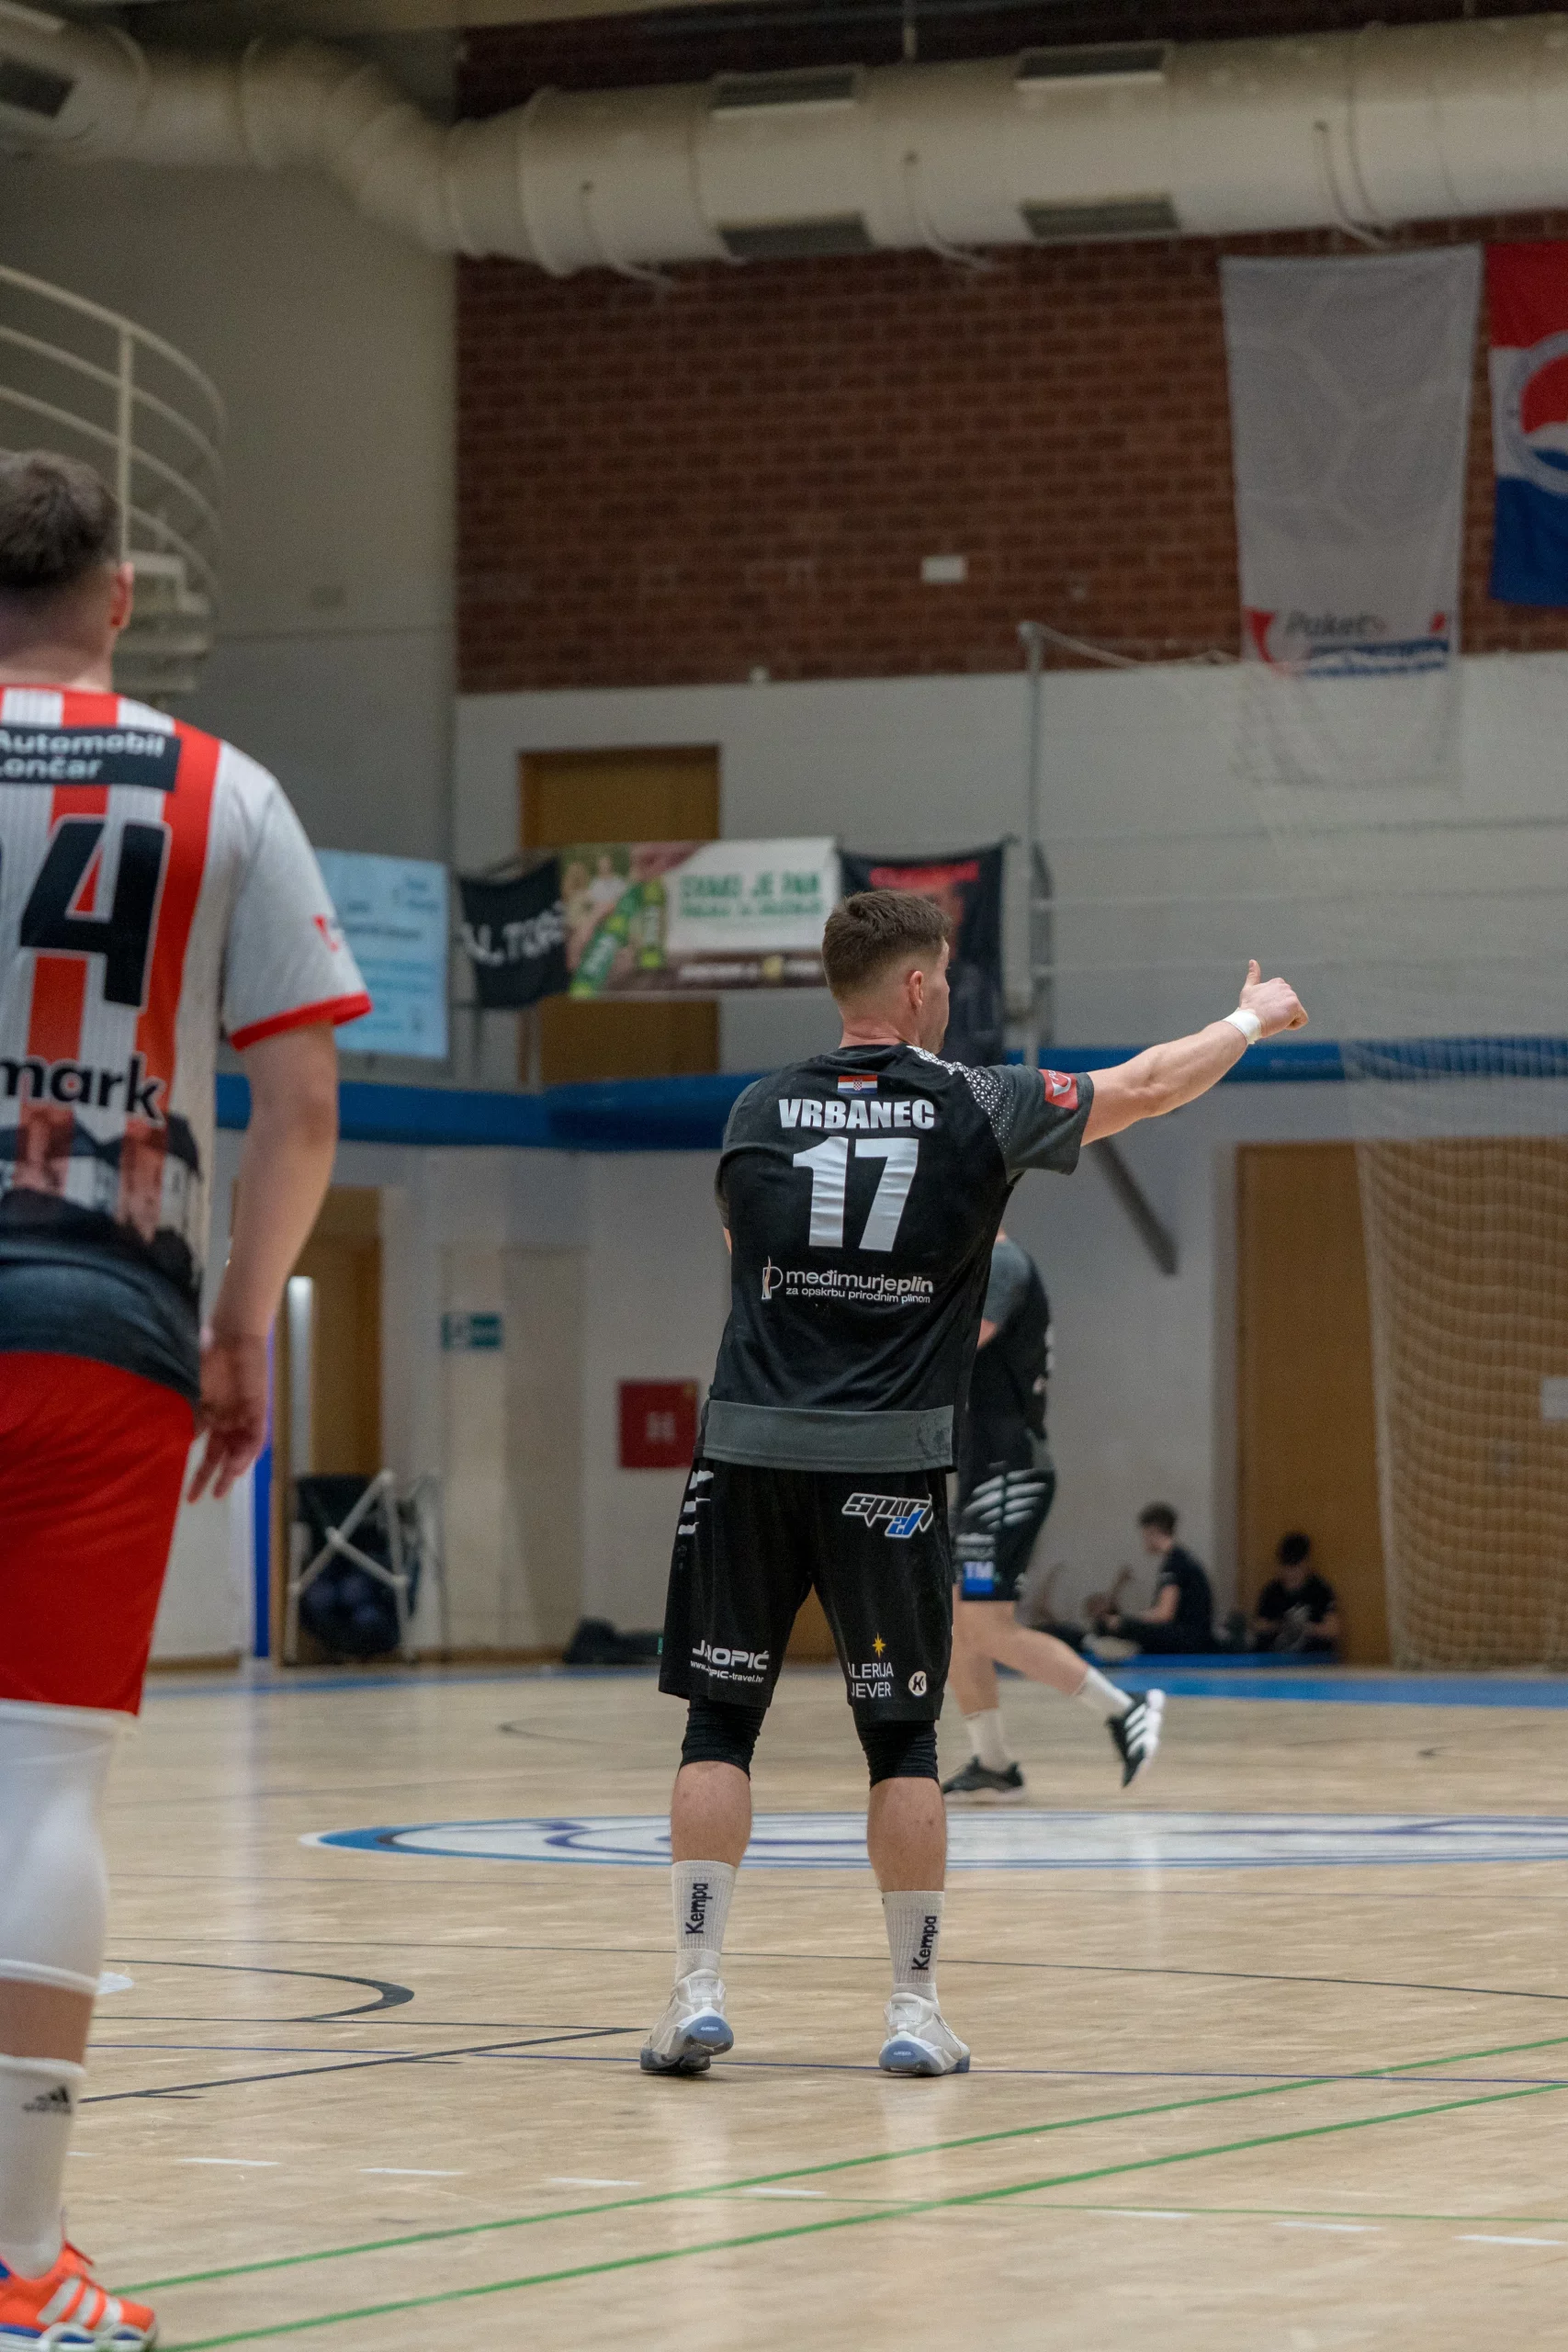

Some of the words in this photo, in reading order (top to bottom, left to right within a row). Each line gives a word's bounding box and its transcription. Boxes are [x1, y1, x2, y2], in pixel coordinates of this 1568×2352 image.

[0, 755, 103, 779] ončar
[778, 1099, 935, 1130] VRBANEC
[793, 1136, 919, 1252] 17
[785, 1287, 799, 1296] za
[801, 1287, 845, 1297] opskrbu
[848, 1290, 898, 1303] prirodnim
[685, 1883, 713, 1935] Kempa
[911, 1915, 939, 1971] Kempa
